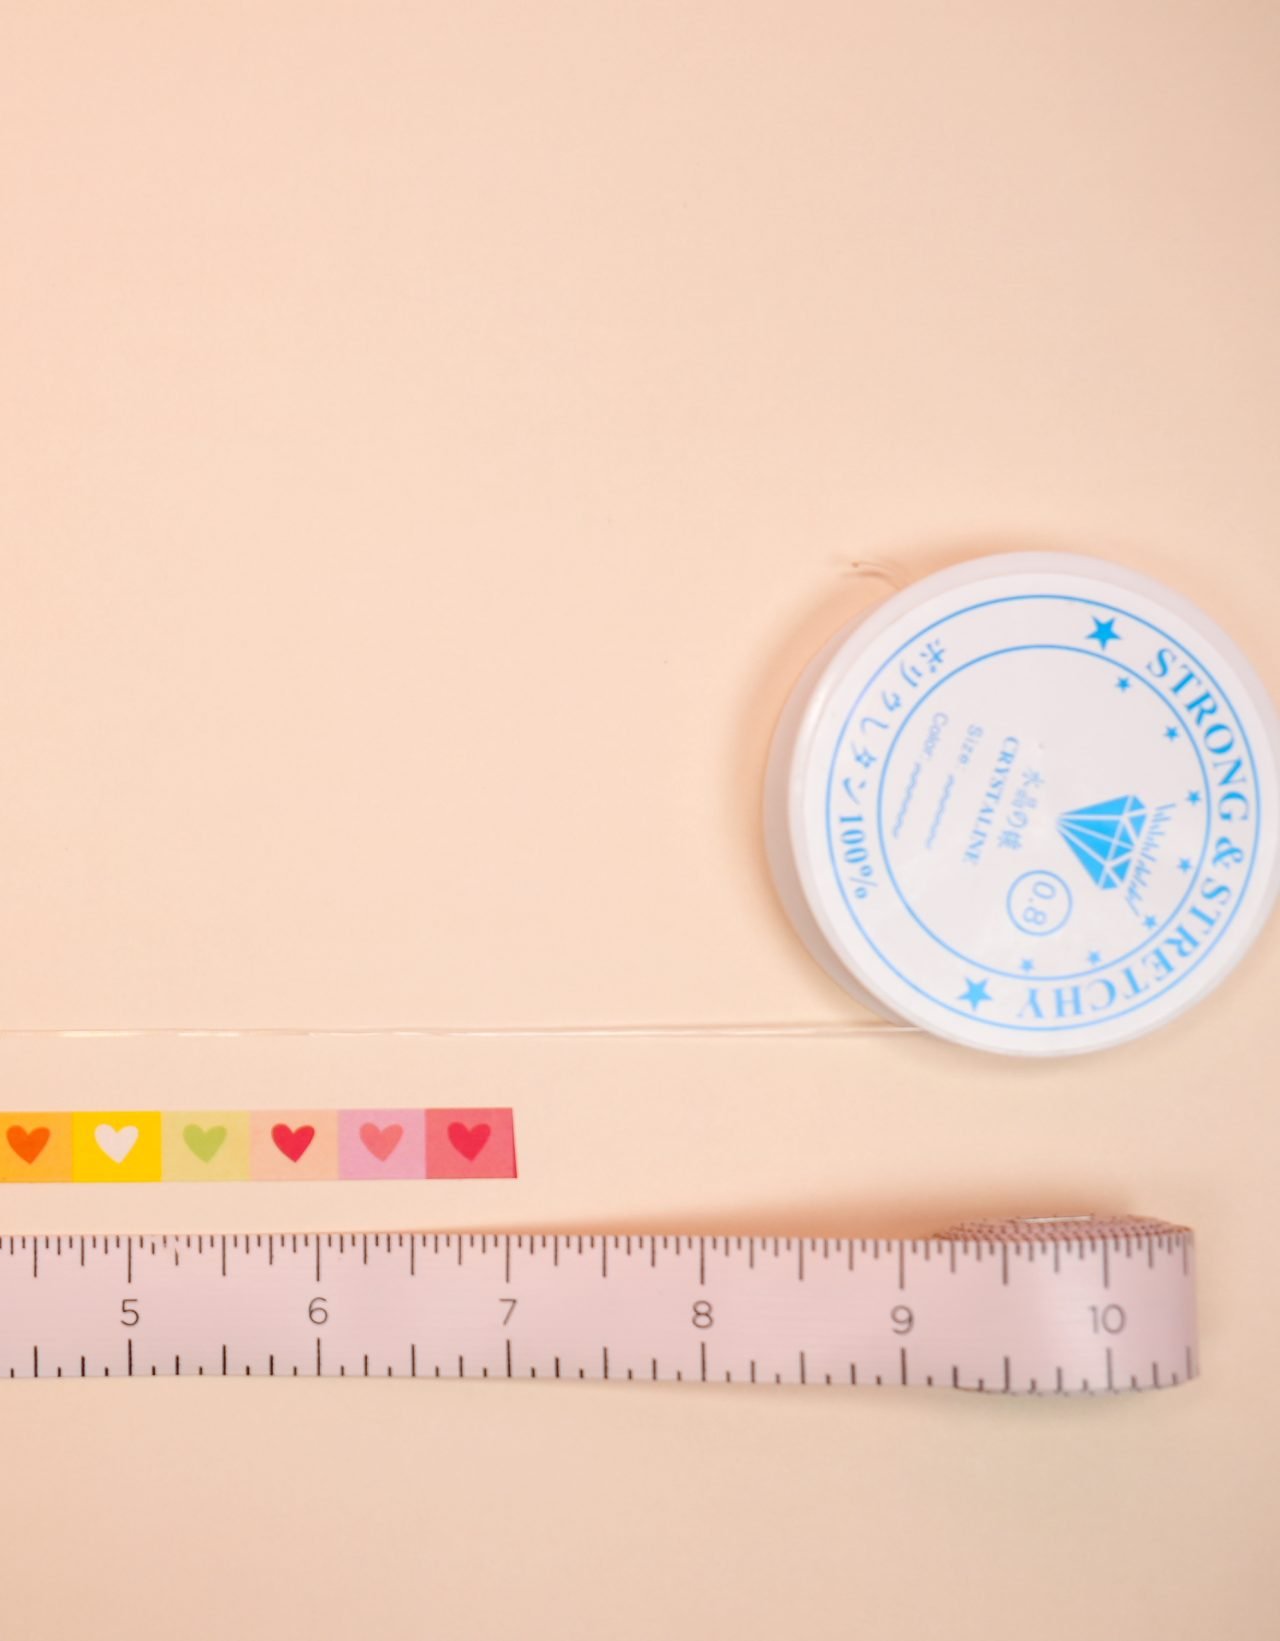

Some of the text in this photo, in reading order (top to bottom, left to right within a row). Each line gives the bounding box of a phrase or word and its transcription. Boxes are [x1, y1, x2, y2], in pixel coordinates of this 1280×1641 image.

[962, 735, 1020, 867] CRYSTALINE
[1016, 647, 1248, 1019] STRONG & STRETCHY
[1022, 880, 1058, 926] 0.8
[120, 1298, 140, 1327] 5
[308, 1297, 329, 1326] 6
[499, 1298, 518, 1326] 7
[691, 1300, 714, 1330] 8
[890, 1305, 915, 1336] 9
[1091, 1304, 1127, 1334] 10
